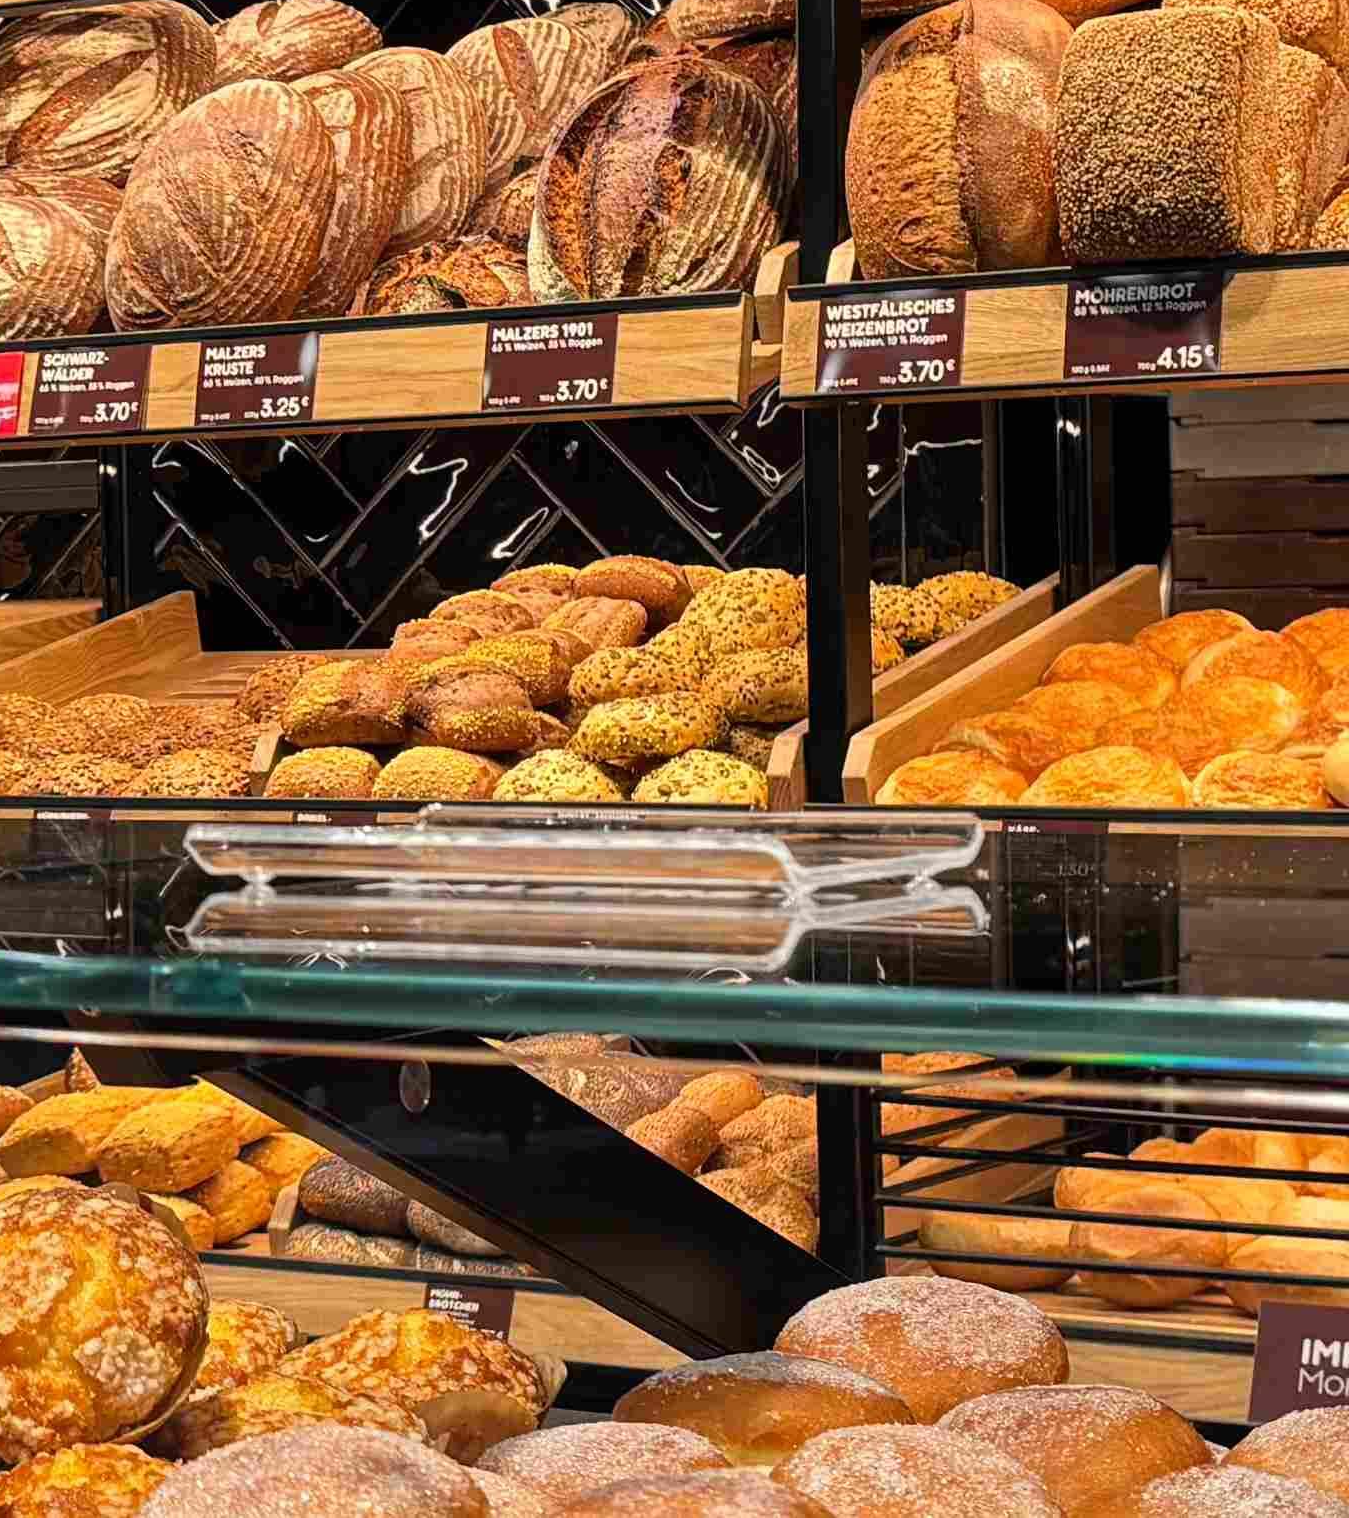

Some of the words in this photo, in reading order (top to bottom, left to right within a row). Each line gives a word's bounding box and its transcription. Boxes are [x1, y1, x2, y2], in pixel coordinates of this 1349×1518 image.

[1075, 282, 1197, 306] MÖHRENBROT
[826, 298, 956, 322] WESTFÄLISCHES
[1100, 303, 1140, 315] Weizen,
[1165, 299, 1208, 313] Roggen
[492, 323, 559, 342] MALZERS
[562, 321, 594, 339] 1901
[825, 317, 930, 339] WEIZENBROT
[567, 337, 604, 350] Roggen
[848, 336, 885, 348] Weizen,
[909, 333, 949, 346] Roggen
[43, 351, 109, 367] SCHWARZ-
[205, 344, 267, 361] MALZERS
[42, 367, 94, 382] WÄLDER
[204, 361, 255, 376] KRUSTE
[272, 374, 304, 386] Roggen
[430, 1289, 463, 1300] MOHN-
[429, 1298, 480, 1313] BRÖTCHEN
